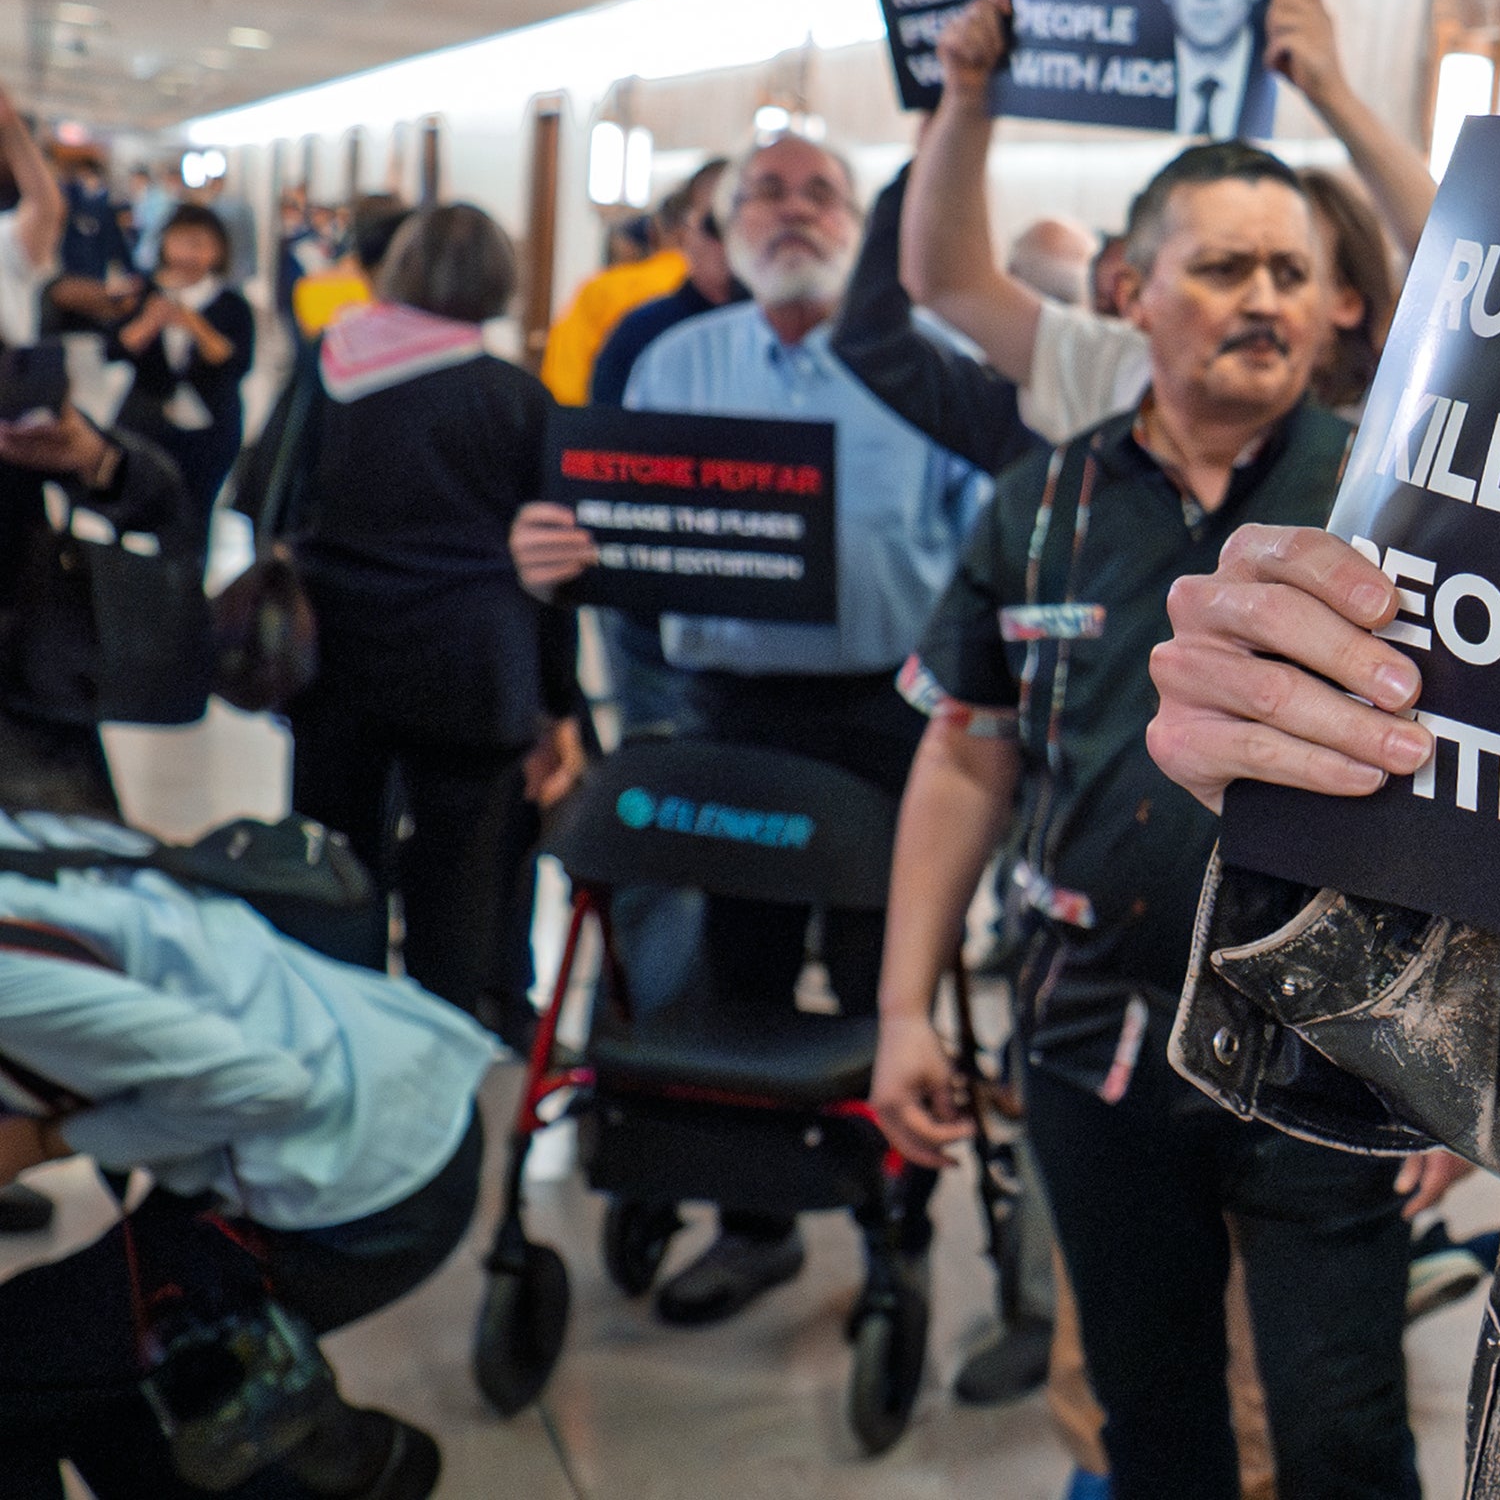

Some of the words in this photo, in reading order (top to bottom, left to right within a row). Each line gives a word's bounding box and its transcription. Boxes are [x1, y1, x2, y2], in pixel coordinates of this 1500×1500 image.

[1012, 0, 1138, 46] PEOPLE
[1010, 51, 1099, 92] WITH
[1101, 54, 1177, 98] AIDS
